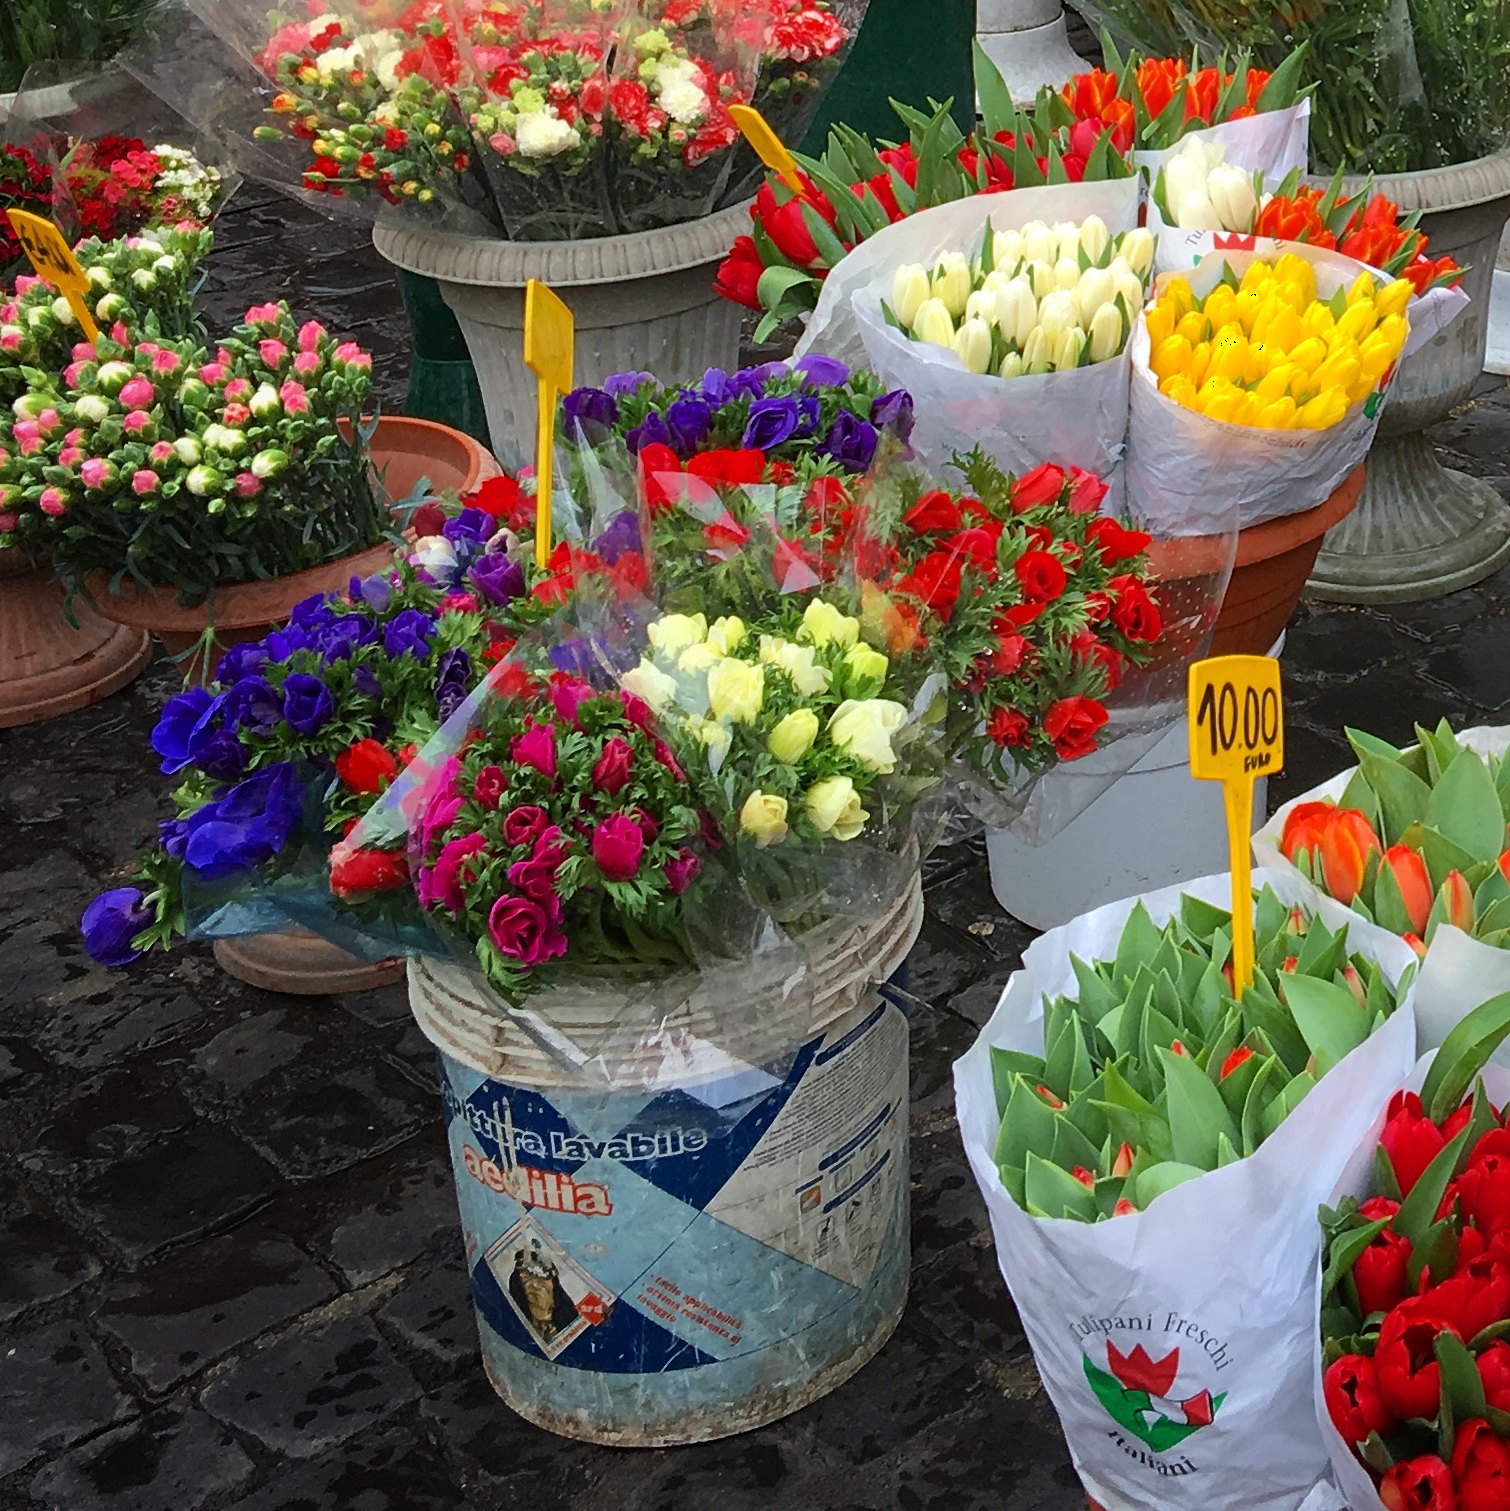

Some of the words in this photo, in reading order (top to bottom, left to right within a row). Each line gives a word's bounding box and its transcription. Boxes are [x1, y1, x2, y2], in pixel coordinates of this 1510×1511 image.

[550, 1126, 708, 1161] lavabile
[463, 1144, 613, 1217] aedilia
[1070, 1314, 1153, 1340] Tulipani
[1164, 1312, 1234, 1371] Freschi
